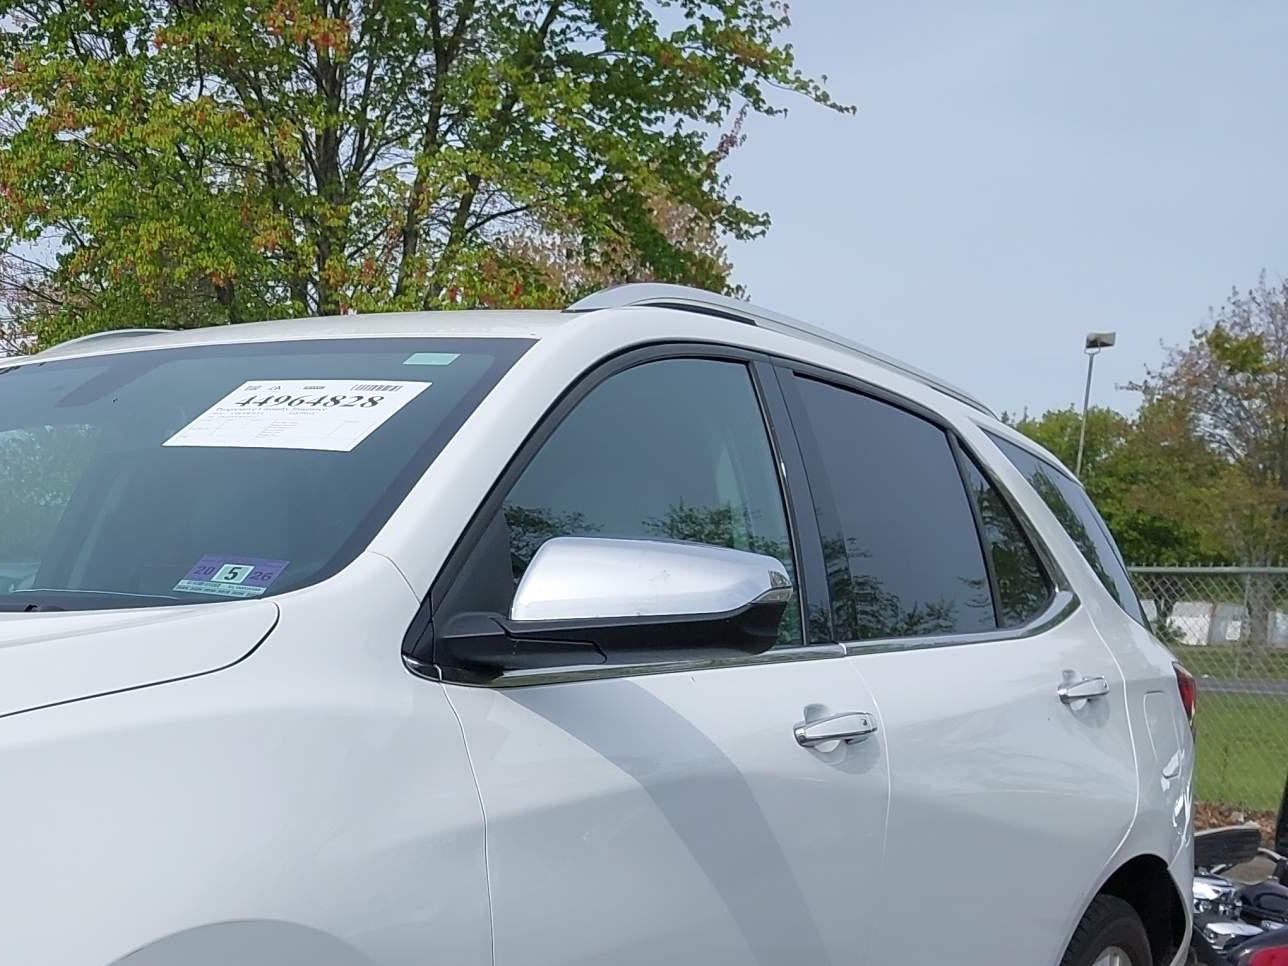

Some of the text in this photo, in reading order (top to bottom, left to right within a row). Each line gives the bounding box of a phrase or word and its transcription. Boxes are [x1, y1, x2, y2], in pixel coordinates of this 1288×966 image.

[235, 394, 385, 408] 44964828
[193, 566, 274, 581] 20 5 26
